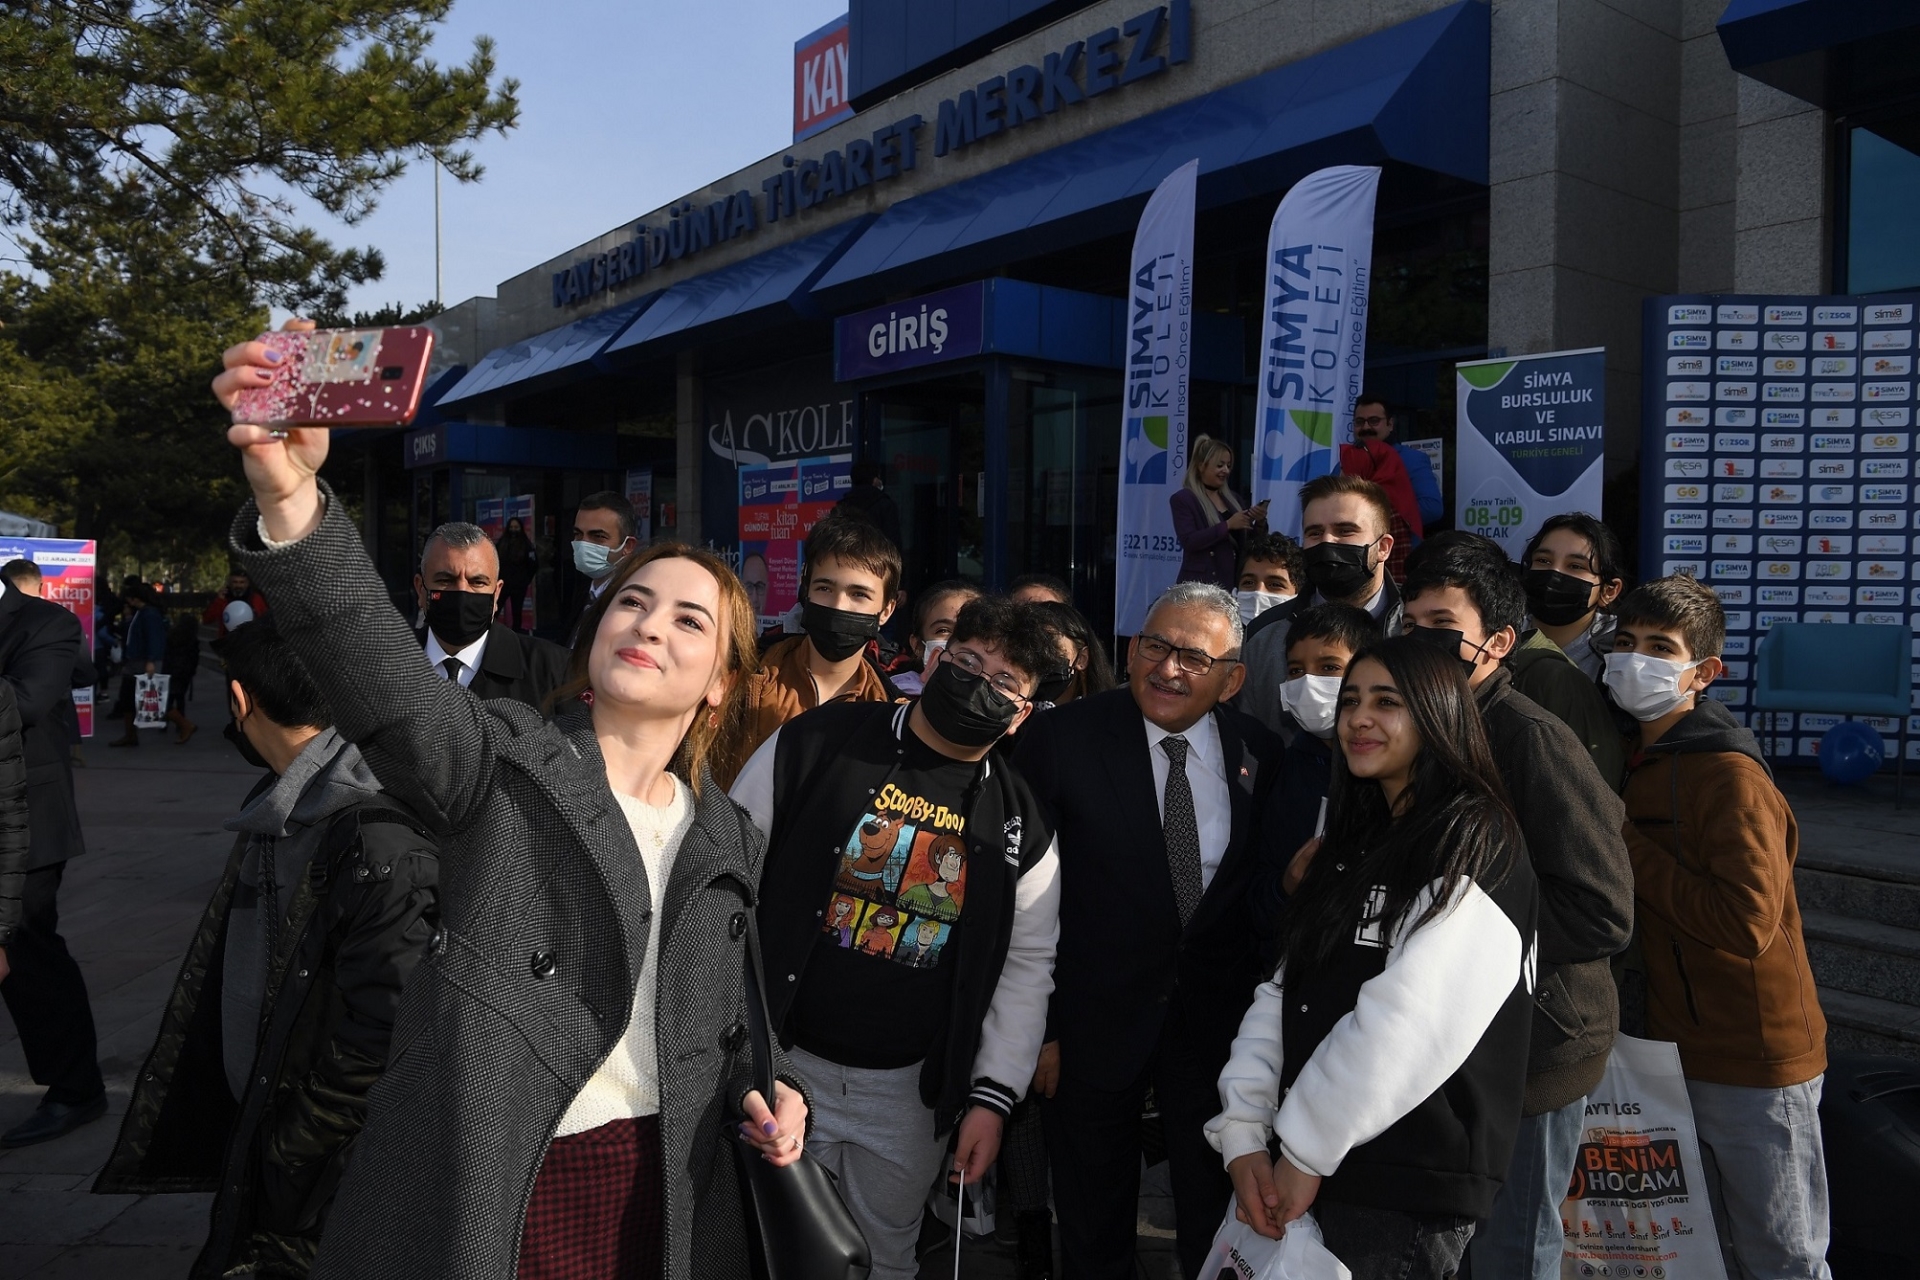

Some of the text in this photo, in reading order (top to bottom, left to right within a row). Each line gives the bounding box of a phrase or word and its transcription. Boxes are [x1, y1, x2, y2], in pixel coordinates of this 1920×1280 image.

[552, 223, 649, 308] KAYSERİ
[648, 201, 757, 269] DÜNYA
[762, 114, 923, 223] TİCARET
[868, 304, 949, 354] GİRİŞ
[1175, 320, 1188, 369] Önce
[1345, 320, 1363, 367] Önce
[1523, 371, 1573, 388] SİMYA
[1501, 388, 1593, 409] BURSLULUK
[1535, 410, 1555, 424] VE
[413, 433, 437, 458] ÇIKIŞ
[1495, 426, 1602, 445] KABUL SINAVI
[1494, 497, 1517, 506] Tarihi
[776, 508, 798, 530] kitap
[1464, 506, 1523, 527] 08-09
[1477, 526, 1509, 538] OCAK
[46, 582, 91, 605] kitap
[1584, 1103, 1641, 1116] AYT LGS
[1589, 1169, 1680, 1193] HOCAM
[1610, 1200, 1629, 1208] ALES
[1650, 1200, 1665, 1208] YDS
[1229, 1246, 1256, 1280] ENGUEN
[1564, 1250, 1678, 1261] www.benimhocam.com
